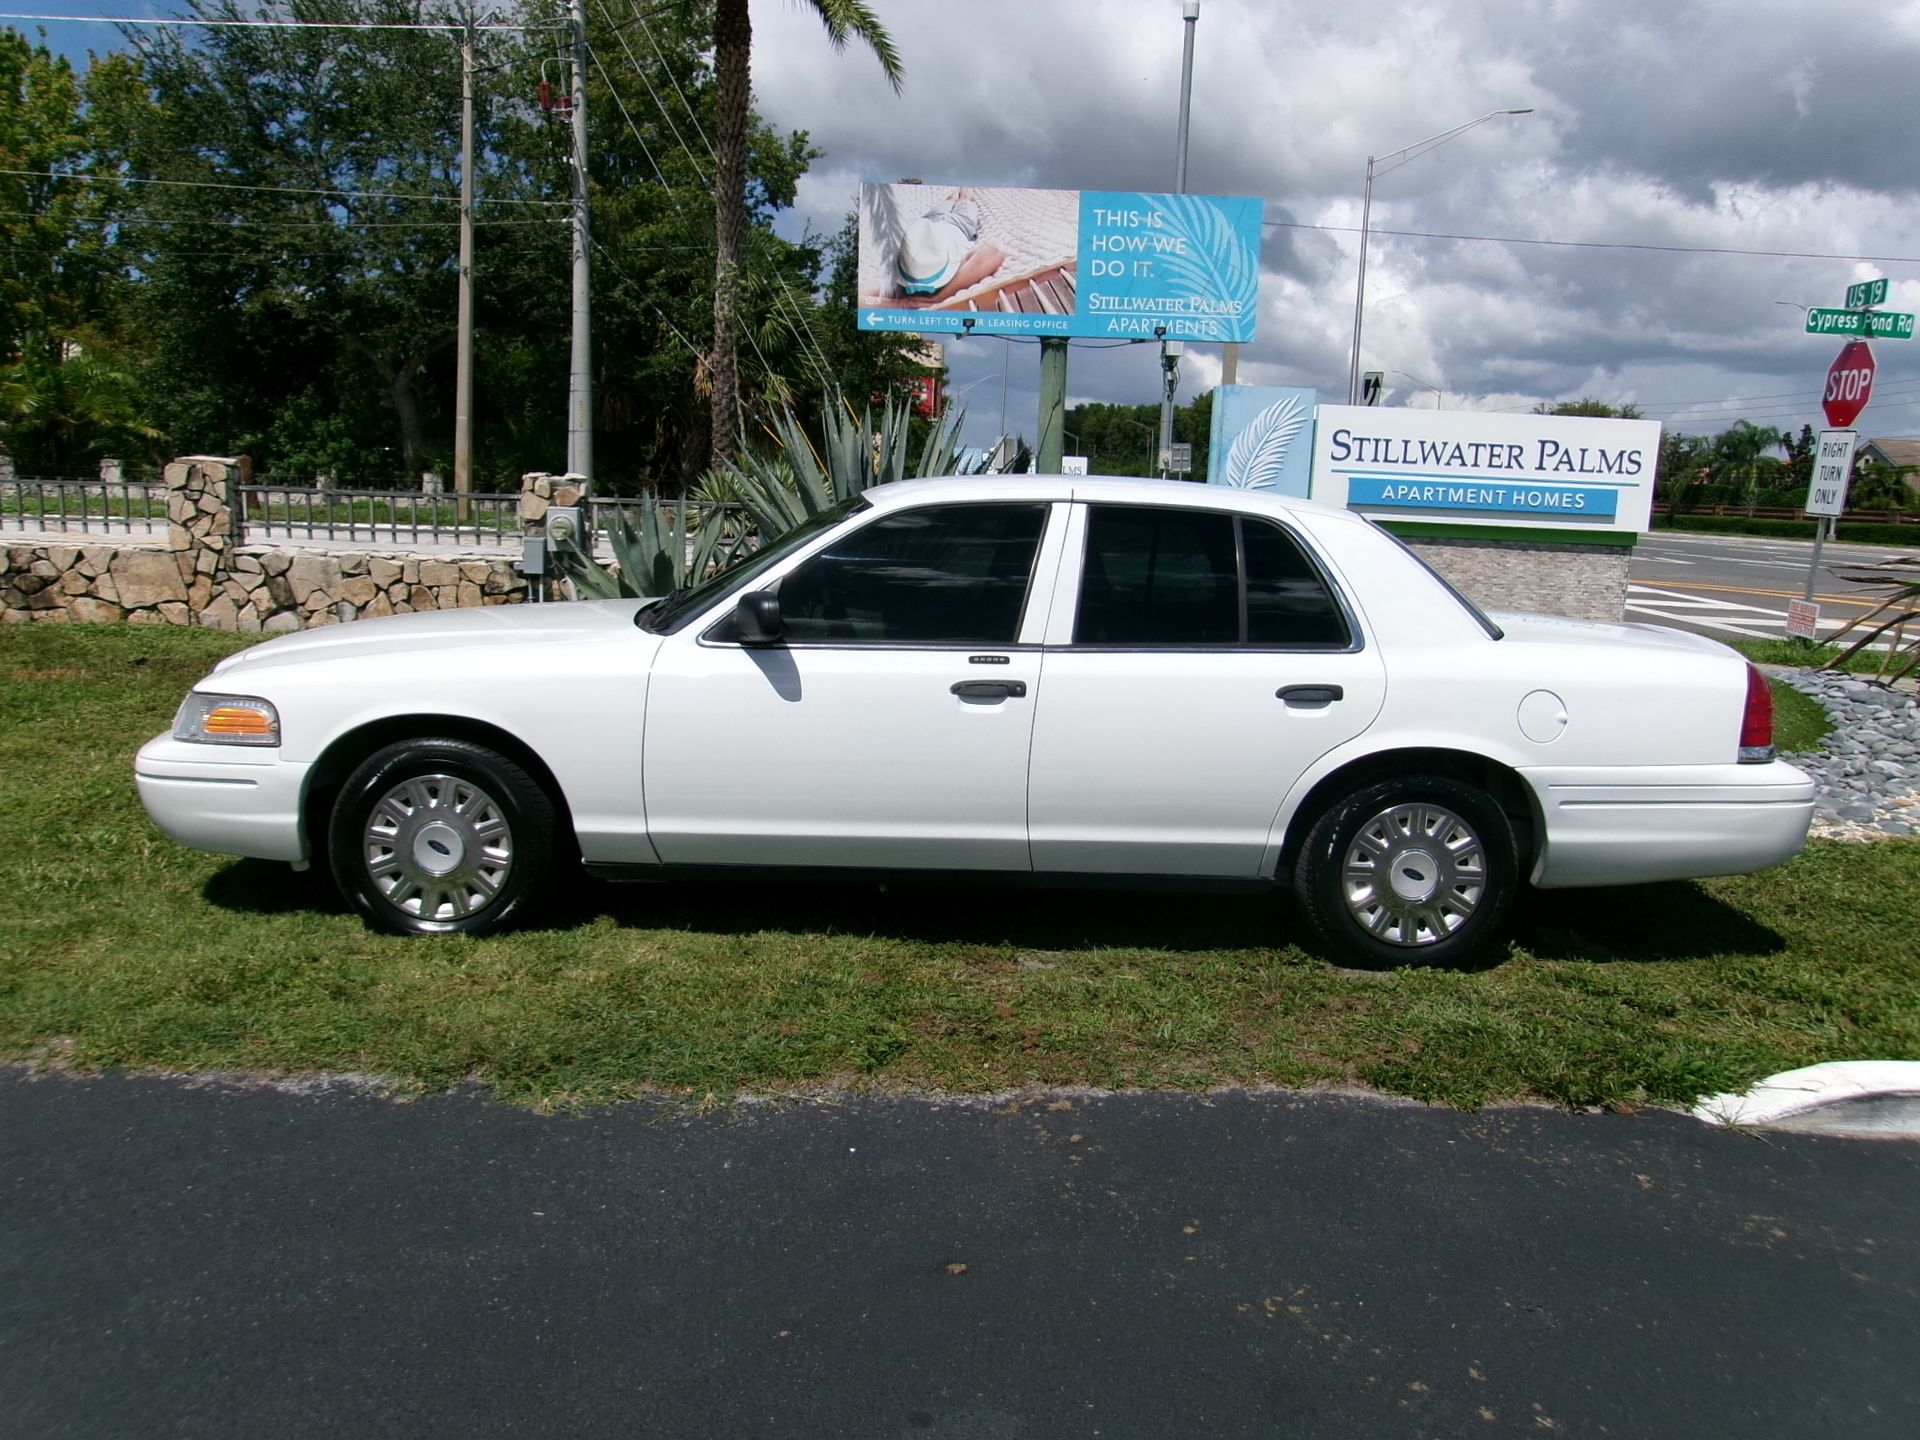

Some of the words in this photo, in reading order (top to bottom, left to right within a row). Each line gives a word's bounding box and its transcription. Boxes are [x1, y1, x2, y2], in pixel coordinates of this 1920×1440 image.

[1093, 209, 1139, 228] THIS
[1147, 210, 1163, 229] IS
[1092, 235, 1148, 253] HOW
[1153, 236, 1187, 254] WE
[1091, 259, 1125, 277] DO
[1133, 260, 1155, 278] IT.
[1088, 292, 1185, 312] STILLWATER
[1188, 295, 1243, 314] PALMS
[1848, 284, 1866, 308] US
[1869, 281, 1884, 305] 19
[887, 315, 916, 325] TURN
[919, 316, 941, 326] LEFT
[945, 317, 959, 326] TO
[988, 318, 1030, 329] LEASING
[1033, 319, 1069, 330] OFFICE
[1107, 317, 1218, 336] APARTMENTS
[1807, 309, 1859, 332] Cypress
[1863, 313, 1895, 331] Pond
[1896, 314, 1914, 333] Rd
[1826, 368, 1871, 402] STOP
[1330, 428, 1525, 470] STILLWATER
[1534, 439, 1642, 476] PALMS
[1821, 442, 1849, 459] RIGHT
[1819, 465, 1843, 482] TURN
[1381, 484, 1507, 506] APARTMENT
[1512, 490, 1586, 509] HOMES
[1814, 488, 1838, 505] ONLY
